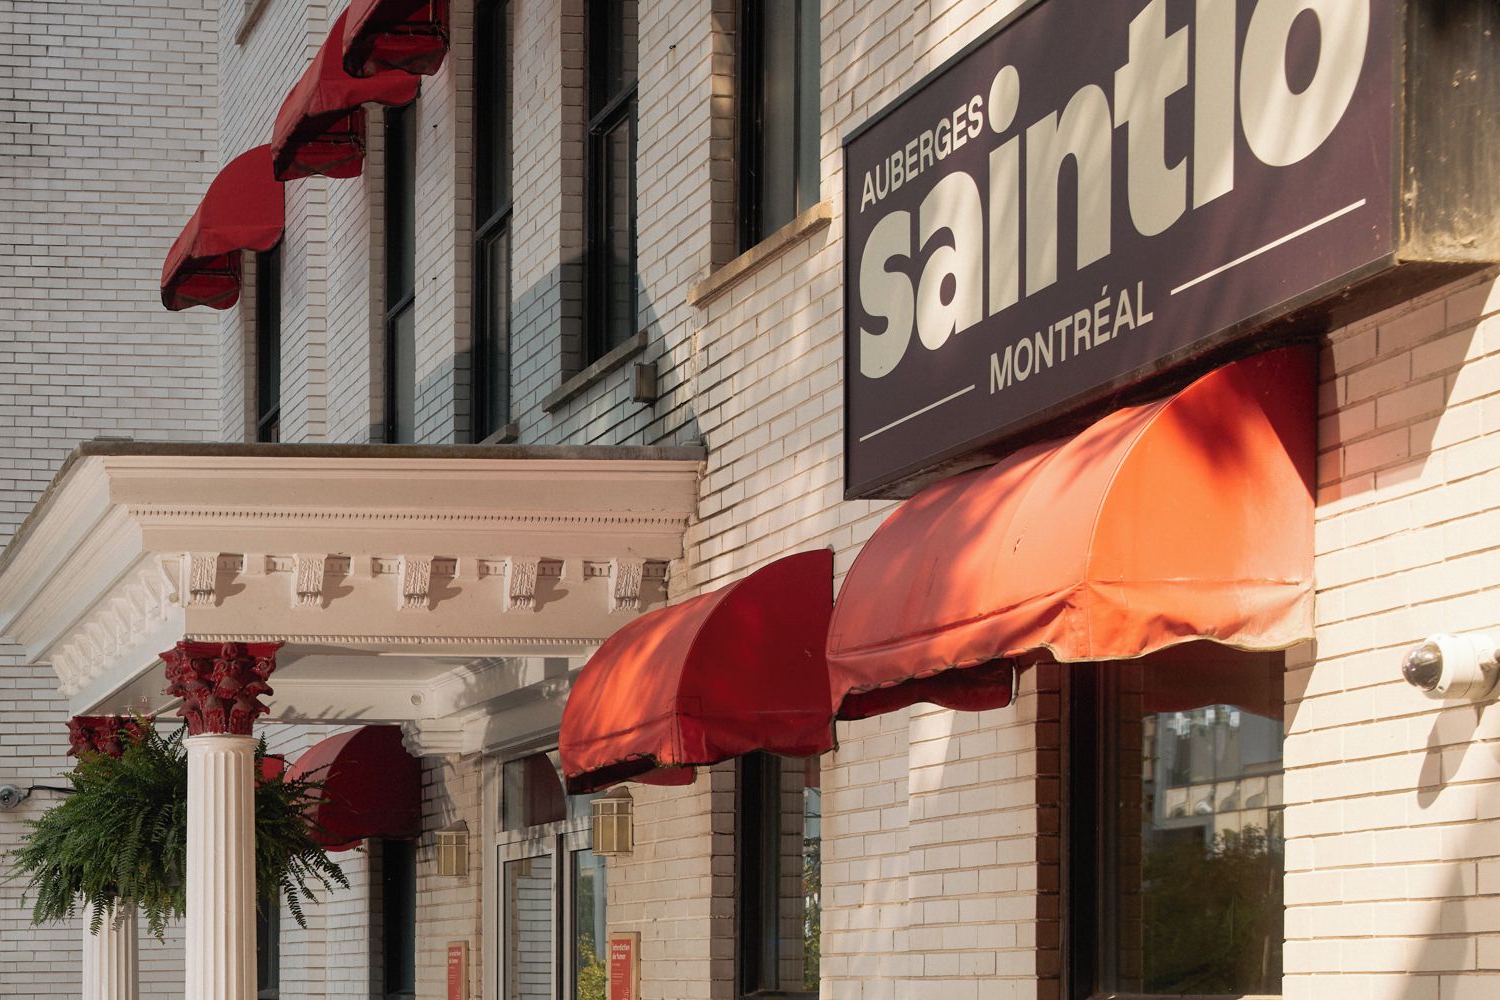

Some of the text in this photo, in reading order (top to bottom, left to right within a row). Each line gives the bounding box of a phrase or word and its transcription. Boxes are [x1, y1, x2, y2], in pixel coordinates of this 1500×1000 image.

[859, 94, 984, 212] AUBERGES
[859, 0, 1370, 378] saintlo
[988, 281, 1154, 394] MONTRÉAL
